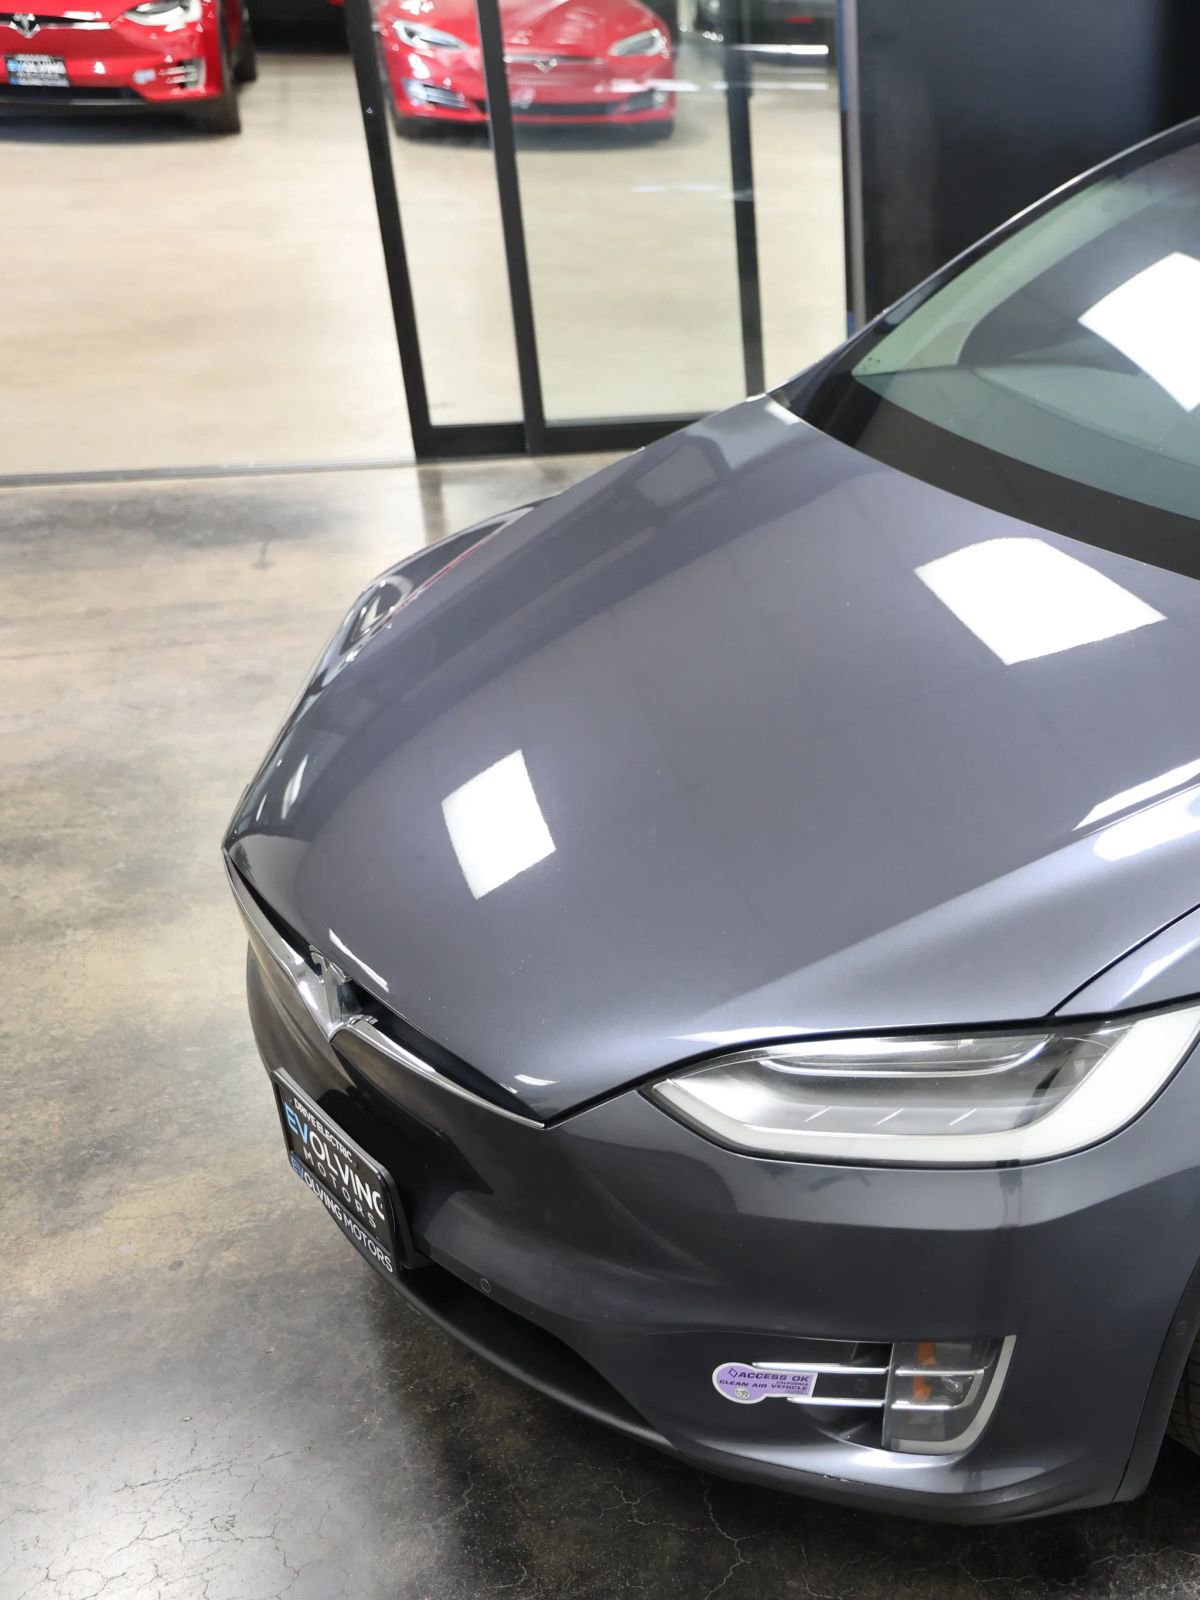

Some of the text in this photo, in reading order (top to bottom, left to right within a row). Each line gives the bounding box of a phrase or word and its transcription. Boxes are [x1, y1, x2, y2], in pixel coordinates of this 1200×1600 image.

[284, 1101, 386, 1221] EVOLVING
[294, 1098, 353, 1164] DRIVE ELECTRIC
[291, 1156, 394, 1273] EVOLVING MOTORS
[303, 1145, 376, 1229] MOTORS
[719, 1379, 749, 1387] CLEAN
[738, 1371, 787, 1381] ACCESS
